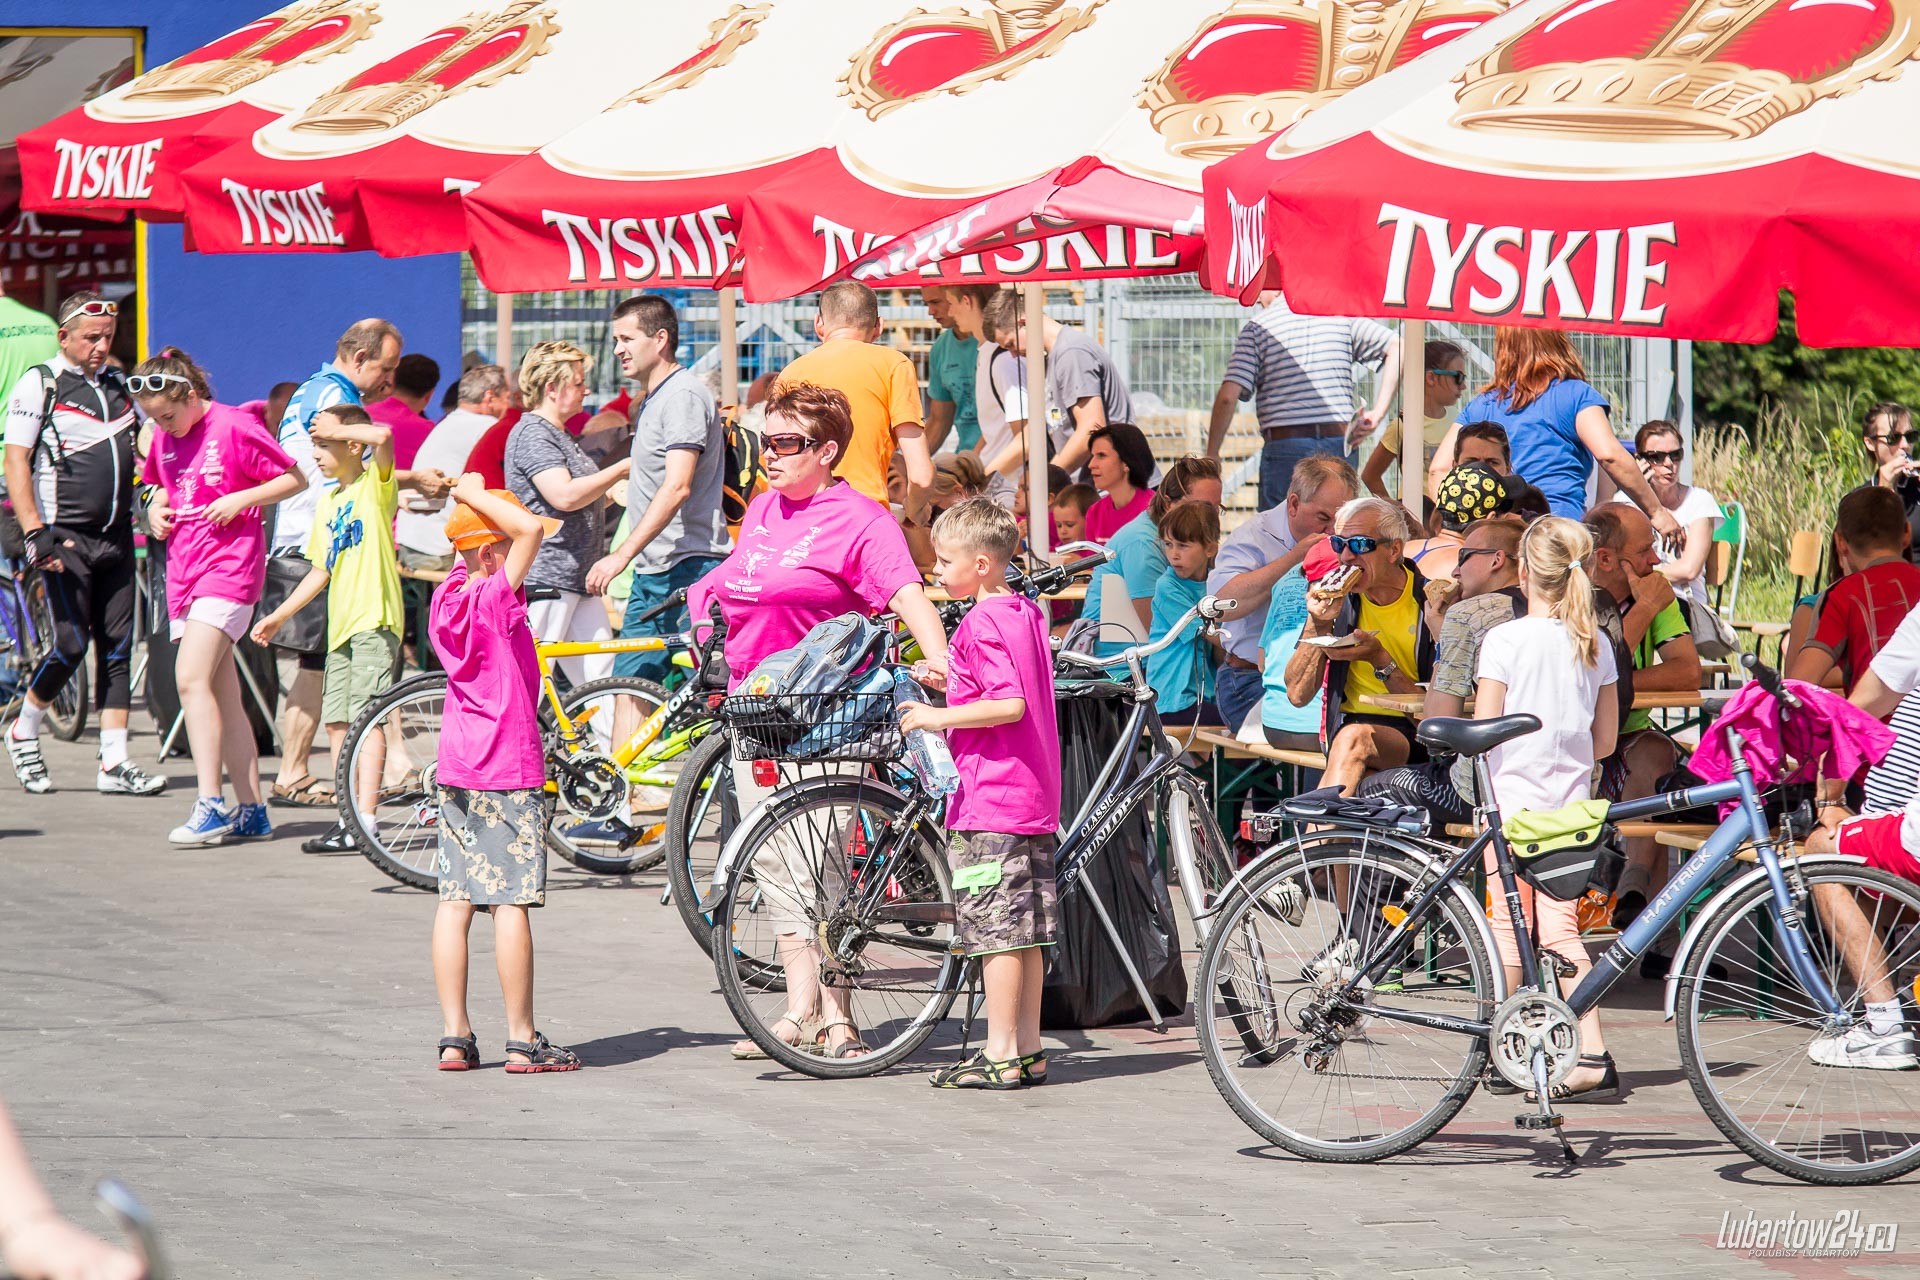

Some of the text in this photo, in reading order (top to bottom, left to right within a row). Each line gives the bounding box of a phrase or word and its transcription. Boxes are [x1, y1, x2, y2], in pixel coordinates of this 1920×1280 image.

[52, 137, 164, 199] TYSKIE
[220, 177, 346, 246] TYSKIE
[541, 203, 745, 282] TYSKIE
[1376, 202, 1678, 326] TYSKIE
[631, 681, 696, 753] AUTHOR
[1077, 796, 1132, 869] DUNLOP
[1080, 793, 1117, 838] CLASSIC
[1641, 847, 1712, 925] HATTRICK
[1426, 1018, 1466, 1030] HATTRICK
